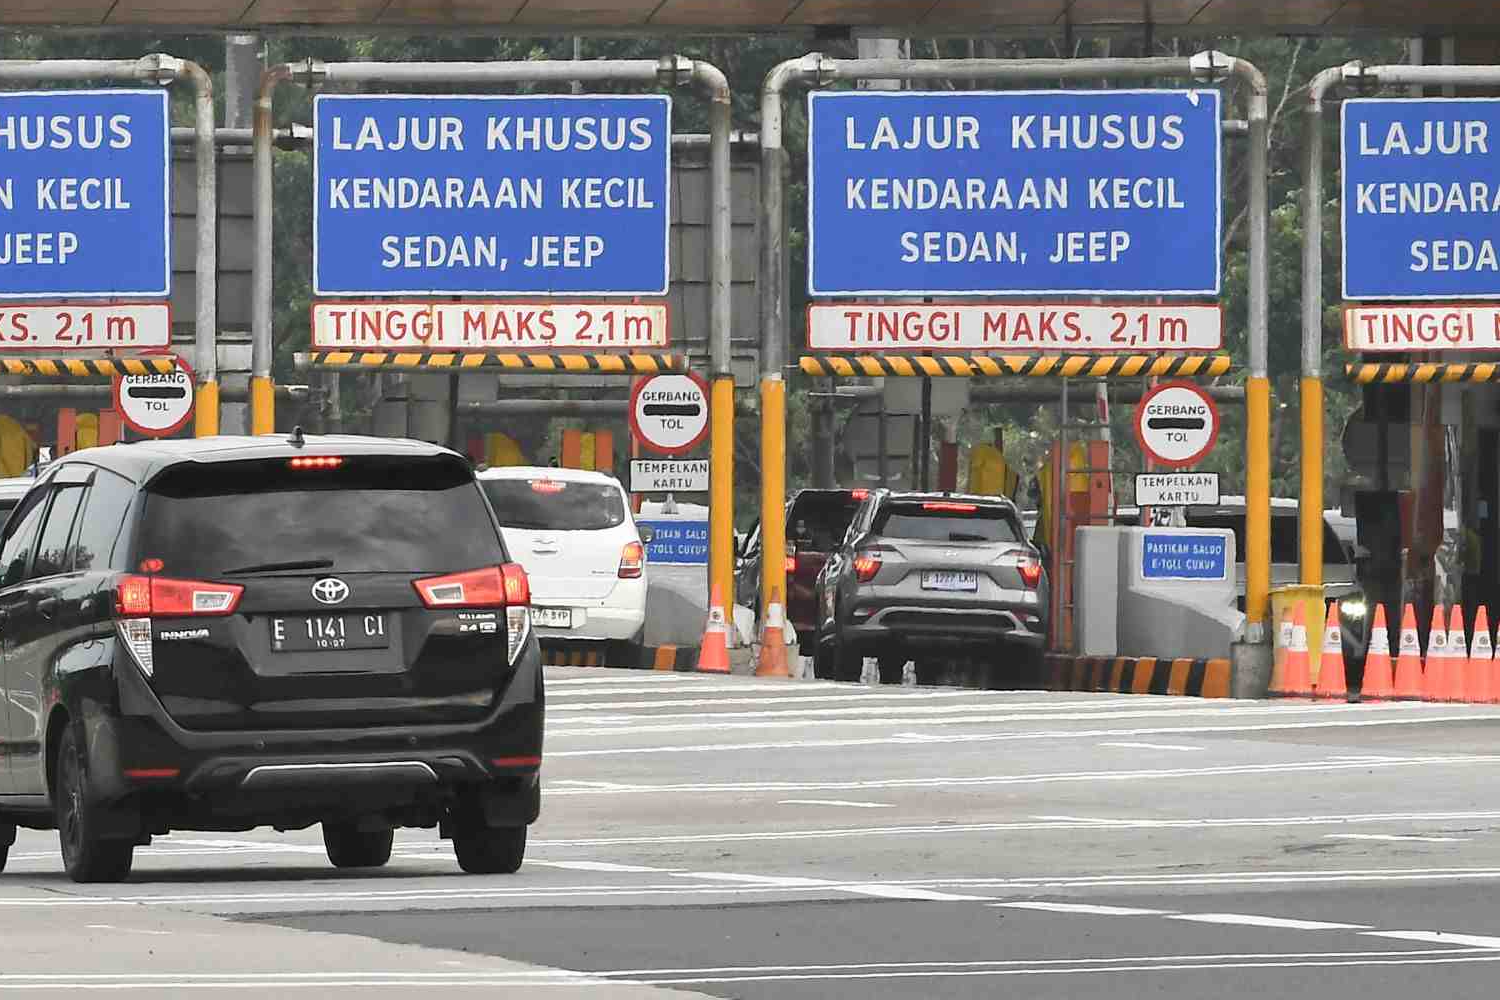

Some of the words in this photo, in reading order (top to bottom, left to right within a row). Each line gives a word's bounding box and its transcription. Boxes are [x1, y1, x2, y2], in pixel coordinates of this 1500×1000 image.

[332, 117, 463, 151] LAJUR
[486, 117, 652, 151] KHUSUS
[846, 115, 980, 150] LAJUR
[1011, 115, 1184, 150] KHUSUS
[1359, 120, 1488, 155] LAJUR
[36, 178, 130, 210] KECIL
[330, 177, 543, 209] KENDARAAN
[562, 177, 654, 209] KECIL
[846, 177, 1068, 210] KENDARAAN
[1088, 177, 1184, 209] KECIL
[381, 236, 508, 271] SEDAN,
[524, 236, 604, 268] JEEP
[900, 232, 1027, 265] SEDAN,
[1049, 231, 1131, 263] JEEP
[329, 311, 444, 341] TINGGI
[844, 312, 960, 341] TINGGI
[983, 312, 1092, 342] MAKS.
[1360, 313, 1474, 344] TINGGI
[126, 375, 186, 384] GERBANG
[145, 400, 170, 411] TOL
[642, 391, 701, 402] GERBANG
[1147, 404, 1206, 416] GERBANG
[659, 418, 684, 430] TOL
[1165, 431, 1189, 443] TOL
[636, 462, 708, 474] TEMPELKAN
[653, 478, 692, 489] KARTU
[1142, 476, 1213, 487] TEMPELKAN
[1158, 491, 1199, 502] KARTU
[1147, 542, 1189, 554] PASTIKAN
[1193, 543, 1222, 554] SALDO
[1186, 559, 1216, 570] CUKUP
[274, 619, 285, 640] E
[305, 617, 346, 638] 1141
[364, 615, 384, 636] CI
